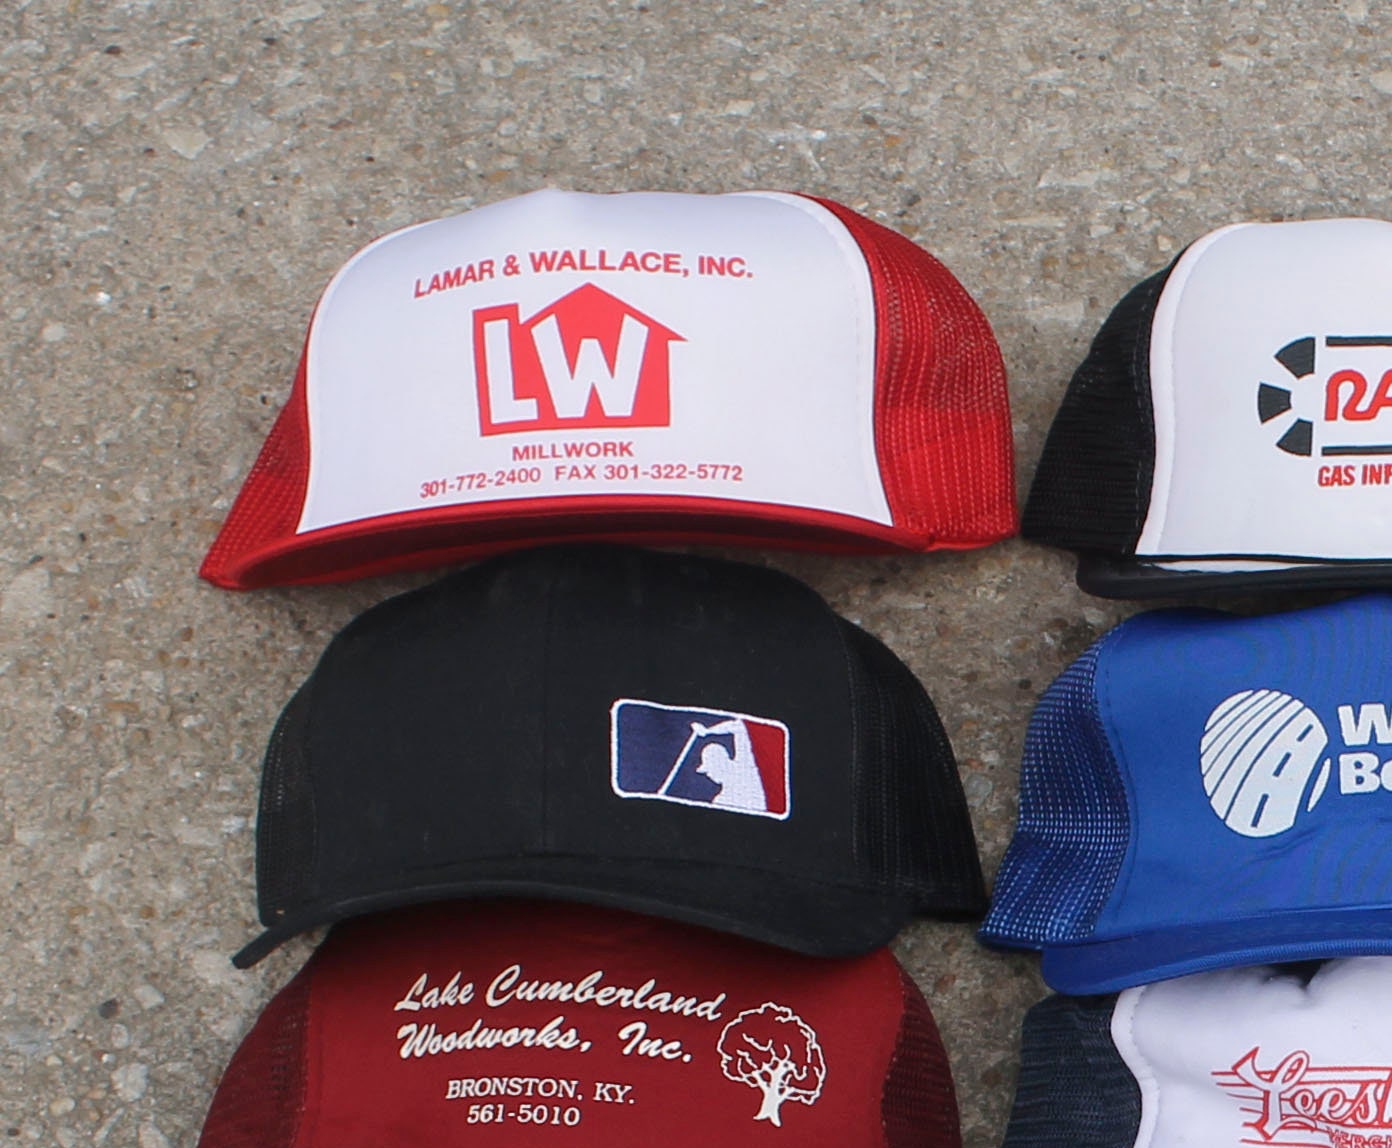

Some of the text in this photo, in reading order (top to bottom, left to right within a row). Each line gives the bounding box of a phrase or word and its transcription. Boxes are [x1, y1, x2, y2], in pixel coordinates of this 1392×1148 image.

[413, 249, 754, 299] LAMAR & WALLACE, INC.
[483, 312, 650, 425] LW
[512, 441, 634, 461] MILLWORK
[419, 463, 743, 499] 301-772-2400 FAX 301-322-5772
[1317, 464, 1356, 487] GAS
[394, 964, 727, 1021] Lake Cumberland
[397, 1016, 693, 1063] Woodworks, Inc.
[445, 1077, 636, 1105] BRONSTON, KY.
[466, 1104, 581, 1127] 561-5010
